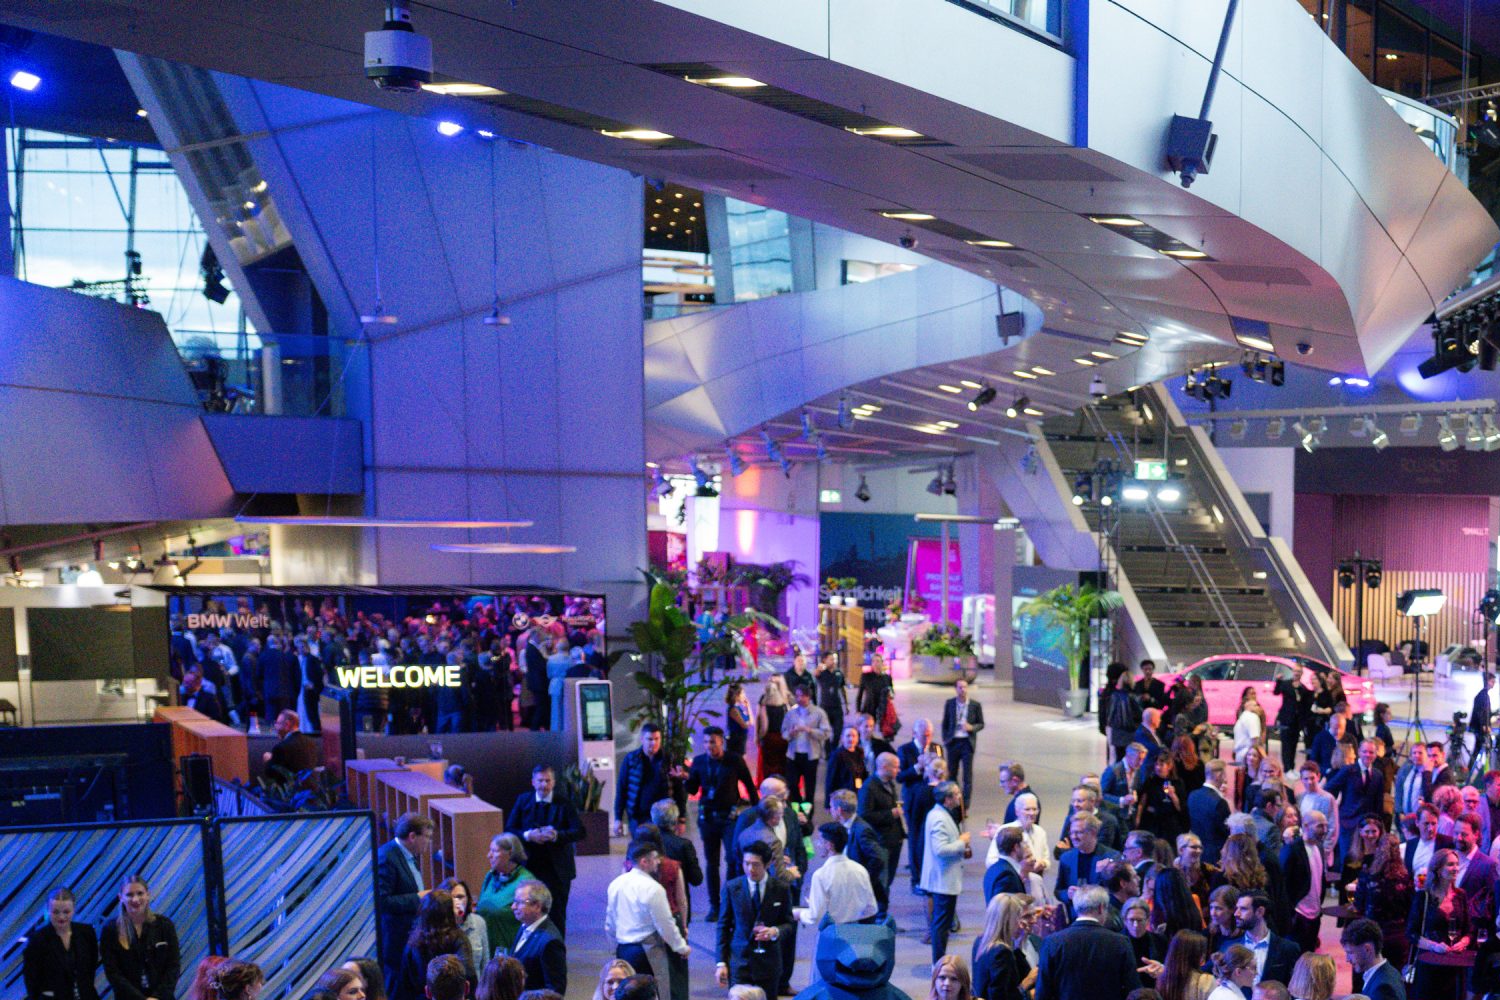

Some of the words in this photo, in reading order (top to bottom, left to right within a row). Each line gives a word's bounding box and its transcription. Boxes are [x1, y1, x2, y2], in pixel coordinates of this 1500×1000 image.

[187, 613, 232, 629] BMW
[233, 613, 269, 629] Welt
[336, 665, 462, 689] WELCOME
